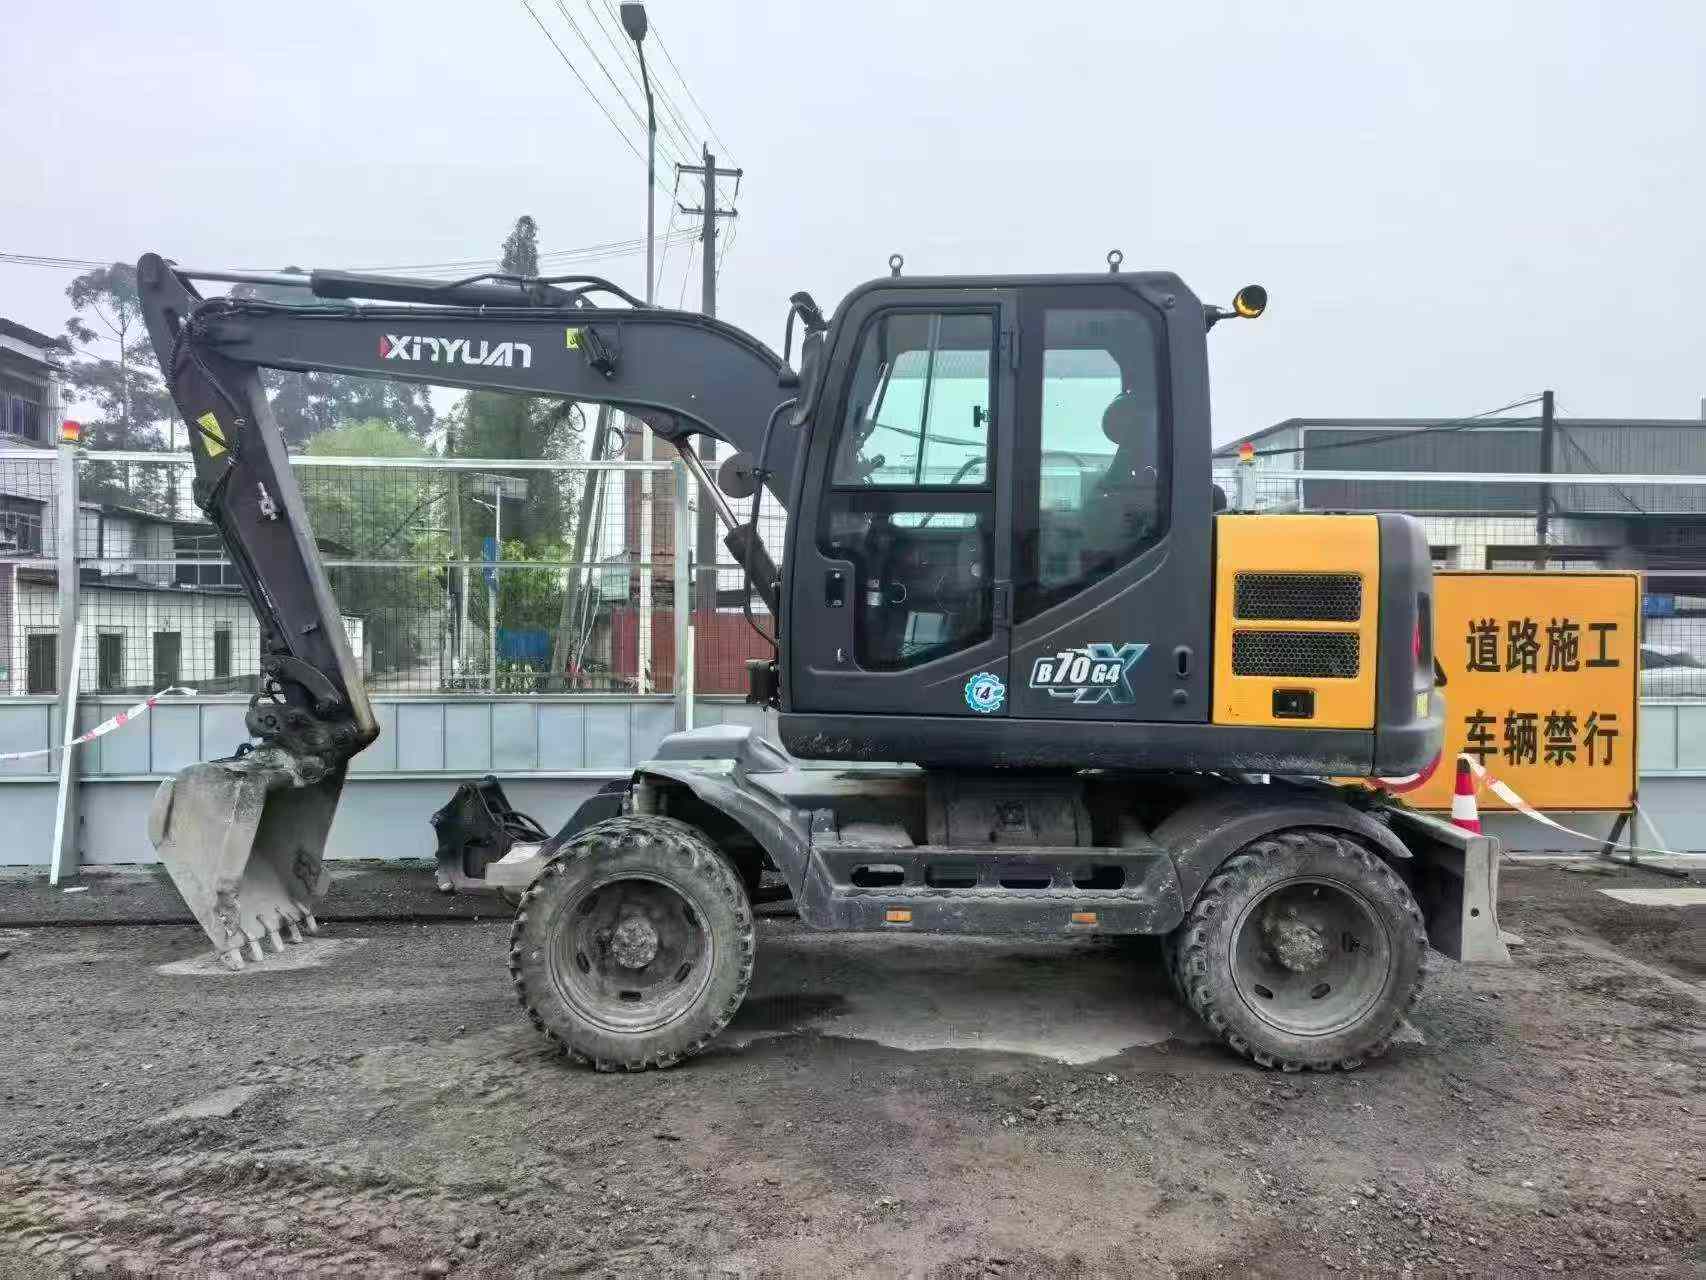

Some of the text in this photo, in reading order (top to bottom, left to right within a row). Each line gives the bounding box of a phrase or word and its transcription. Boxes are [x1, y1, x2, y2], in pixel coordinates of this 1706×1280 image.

[1466, 617, 1620, 673] 道路施工
[1464, 709, 1619, 767] 车辆禁行
